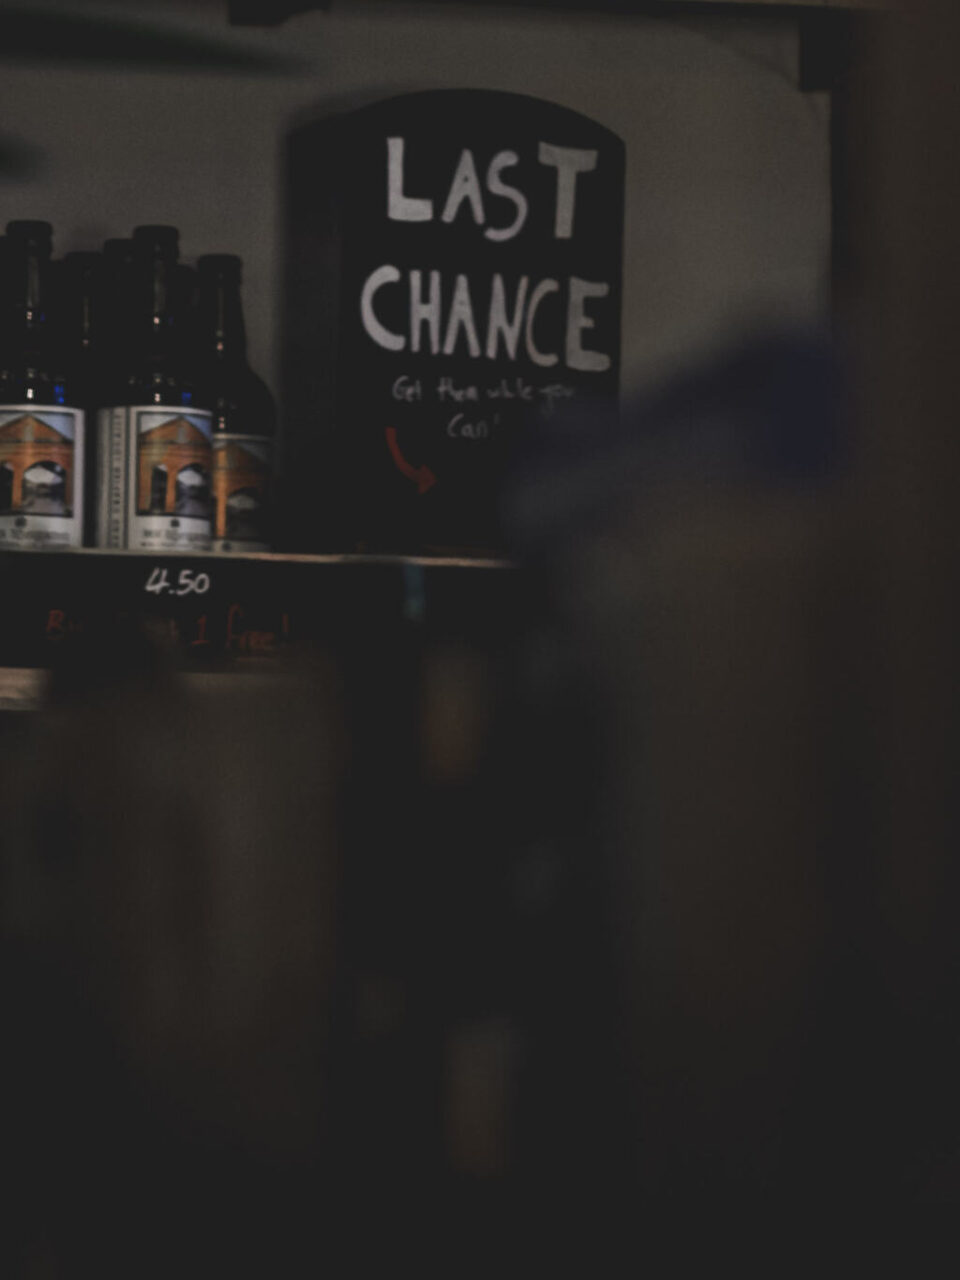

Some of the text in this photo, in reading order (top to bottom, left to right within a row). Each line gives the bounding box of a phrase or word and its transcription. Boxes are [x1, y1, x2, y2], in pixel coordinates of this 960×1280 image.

[386, 135, 599, 242] LAST
[360, 264, 612, 372] CHANCE
[391, 375, 423, 403] Get
[144, 566, 211, 596] 4.50
